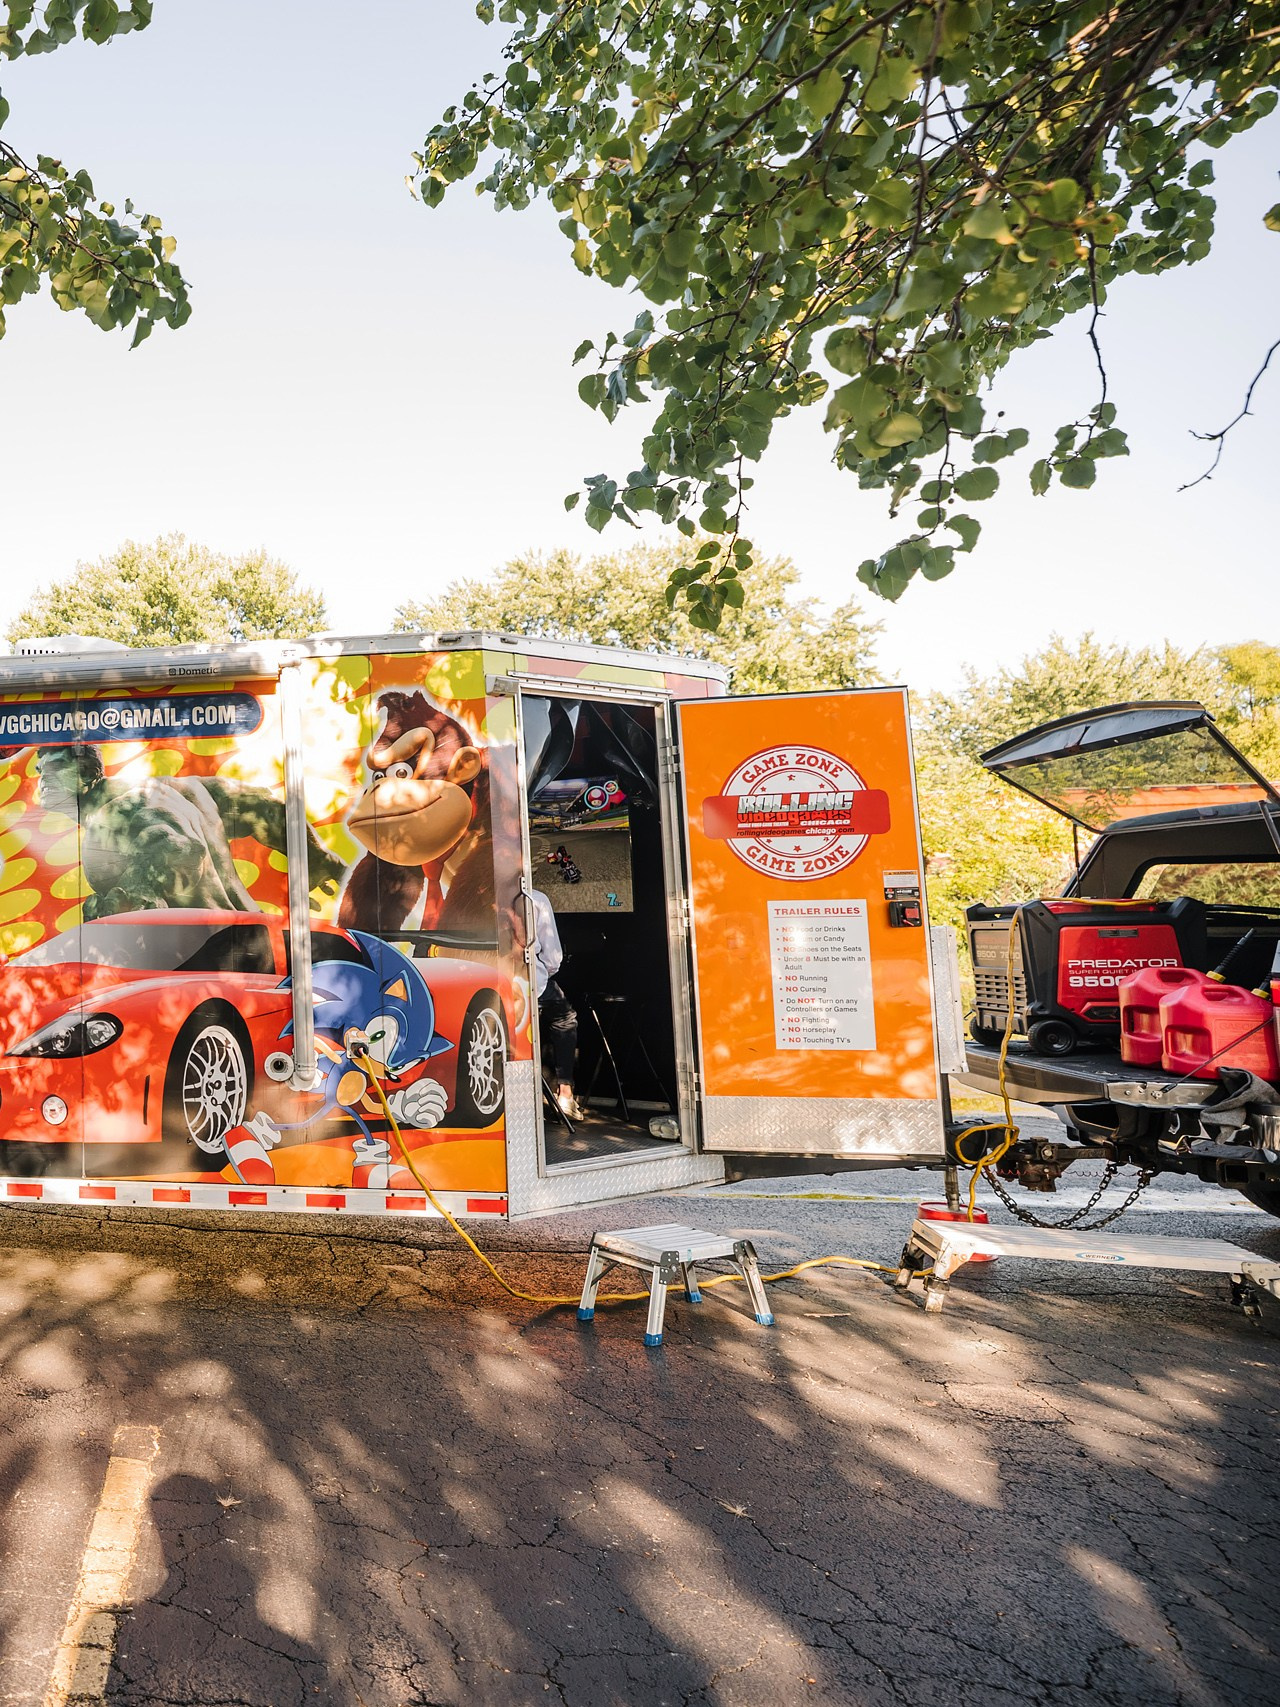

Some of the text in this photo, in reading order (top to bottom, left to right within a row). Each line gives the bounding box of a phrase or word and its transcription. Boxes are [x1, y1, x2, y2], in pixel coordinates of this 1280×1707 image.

[178, 667, 218, 676] Dometic
[742, 753, 844, 783] GAME ZONE
[737, 792, 854, 814] ROLLING
[737, 810, 852, 826] videogames
[737, 827, 855, 837] rollingvideogameschicago.com
[746, 845, 850, 873] GAME ZONE
[1000, 951, 1020, 959] 70
[1068, 958, 1178, 968] PREDATOR
